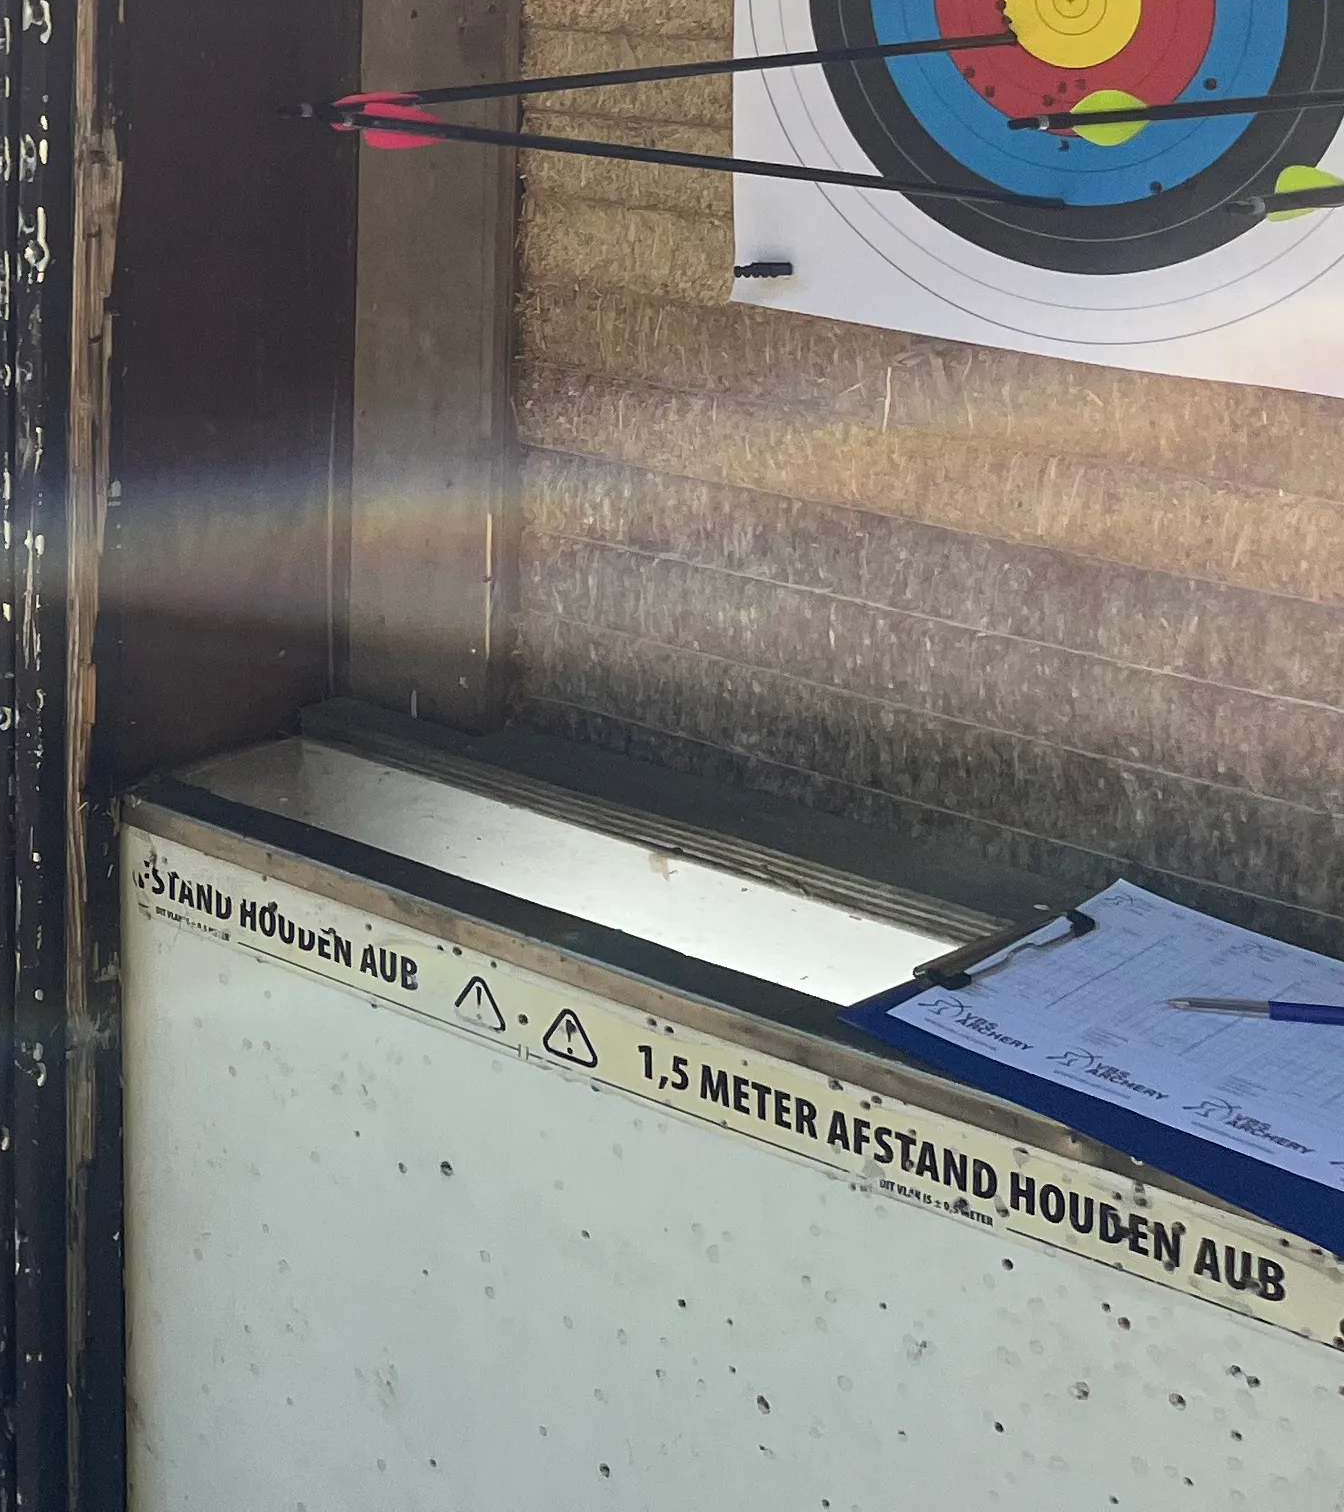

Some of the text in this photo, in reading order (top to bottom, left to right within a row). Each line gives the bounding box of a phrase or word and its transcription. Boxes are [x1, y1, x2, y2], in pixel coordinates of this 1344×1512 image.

[132, 859, 232, 920] STAND
[240, 898, 352, 968] HOUDEN
[360, 943, 419, 991] AUB
[954, 1018, 1034, 1050] ARCHERY
[1084, 1068, 1169, 1099] ARCHERY
[637, 1044, 1287, 1302] 1,5 METER AFSTAND HOUDEN AUB
